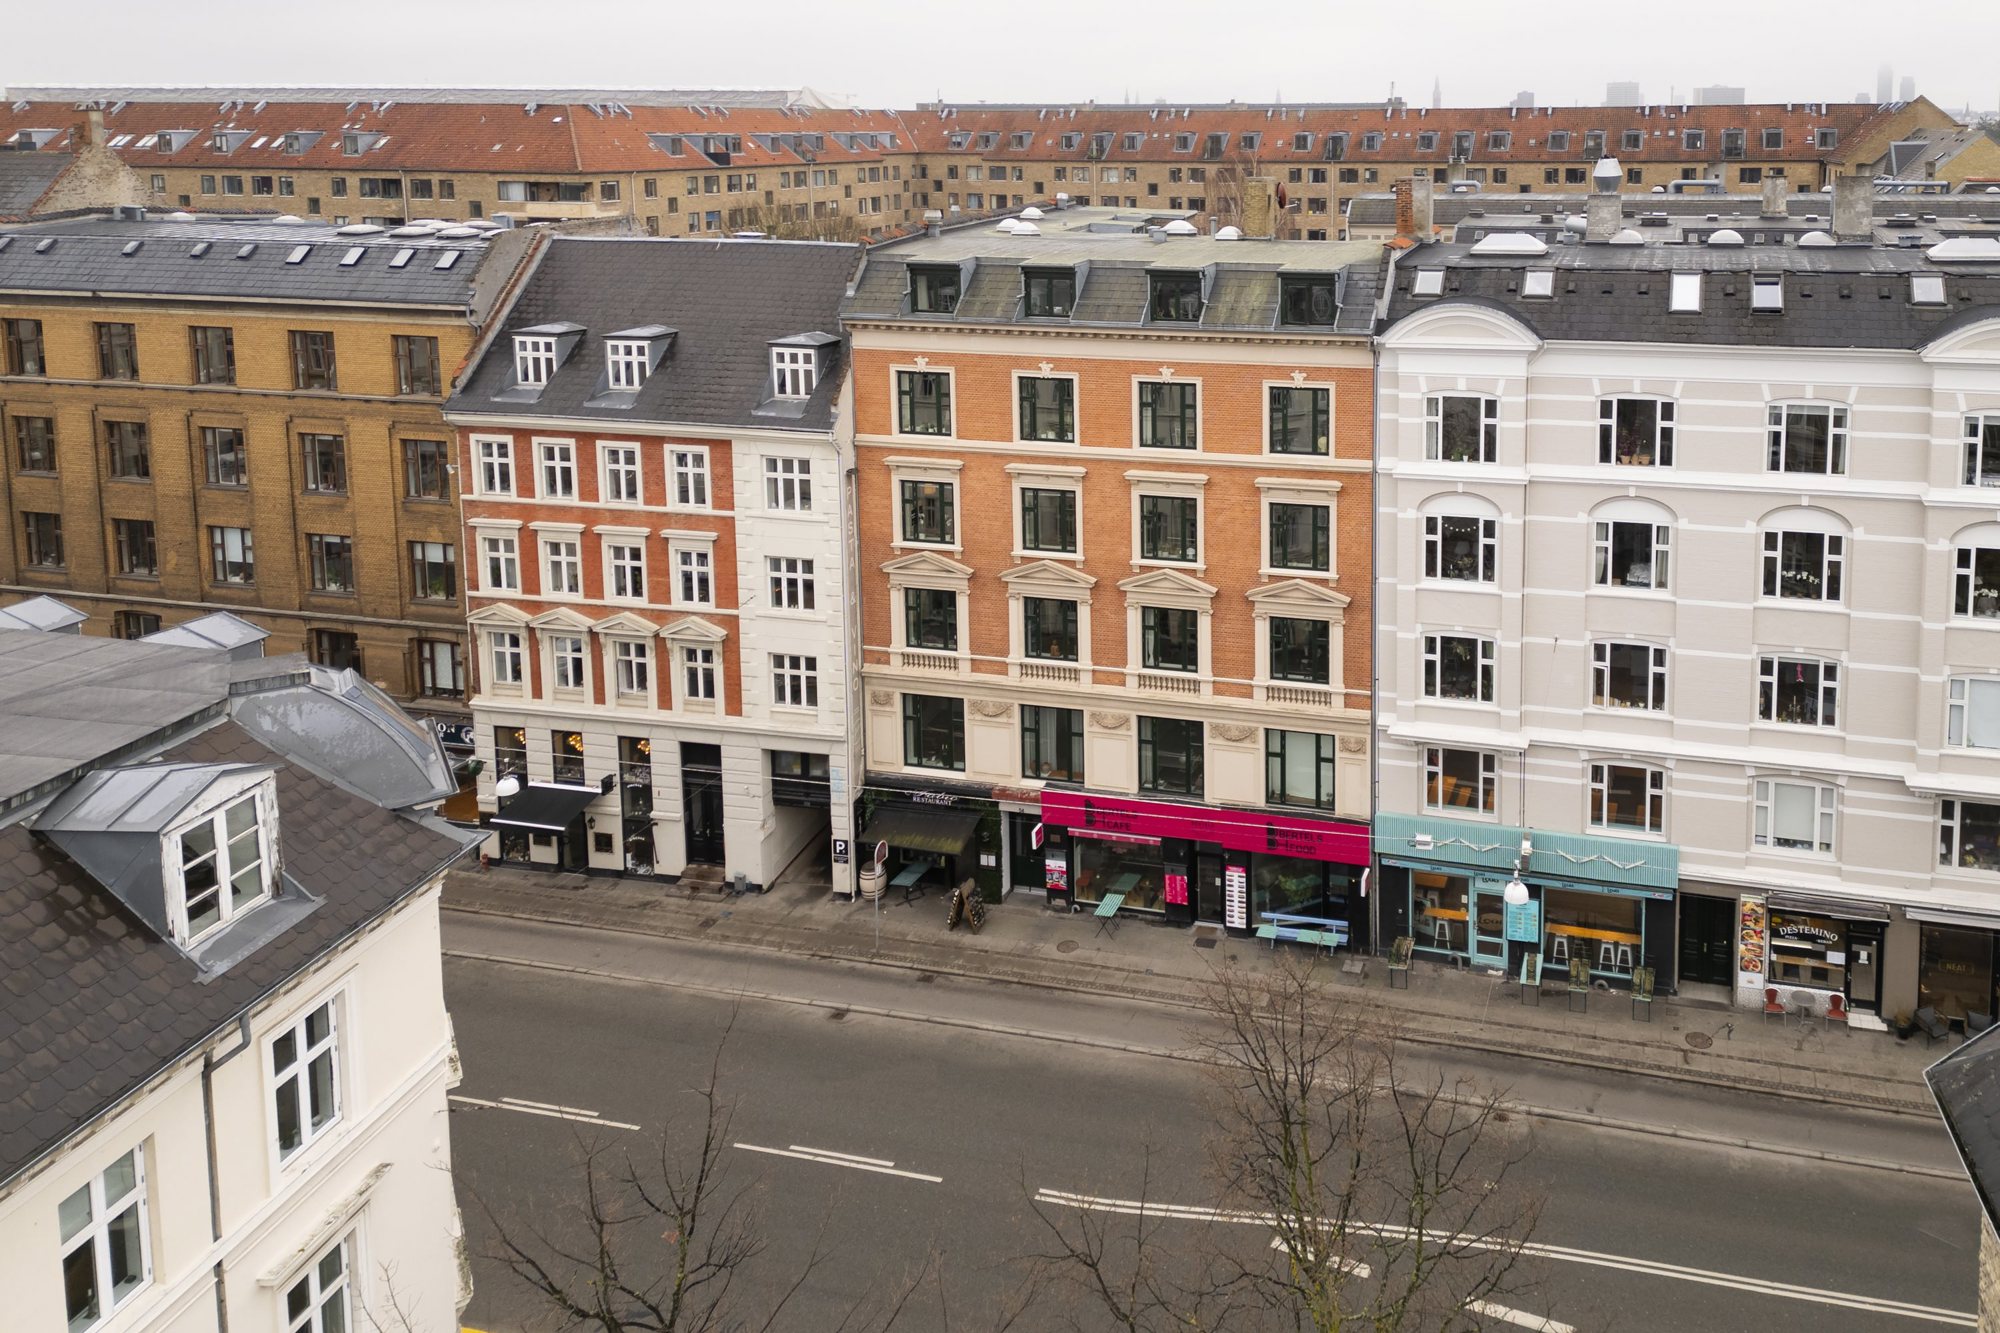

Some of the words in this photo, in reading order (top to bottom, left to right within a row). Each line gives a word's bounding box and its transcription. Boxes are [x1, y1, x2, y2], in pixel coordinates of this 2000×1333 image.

[847, 486, 855, 571] PASTA
[851, 624, 859, 691] VINO
[912, 796, 952, 806] RESTAURANT
[1279, 831, 1324, 843] BERTELS
[1289, 843, 1317, 855] FOOD
[1779, 925, 1838, 941] DESTEMINO
